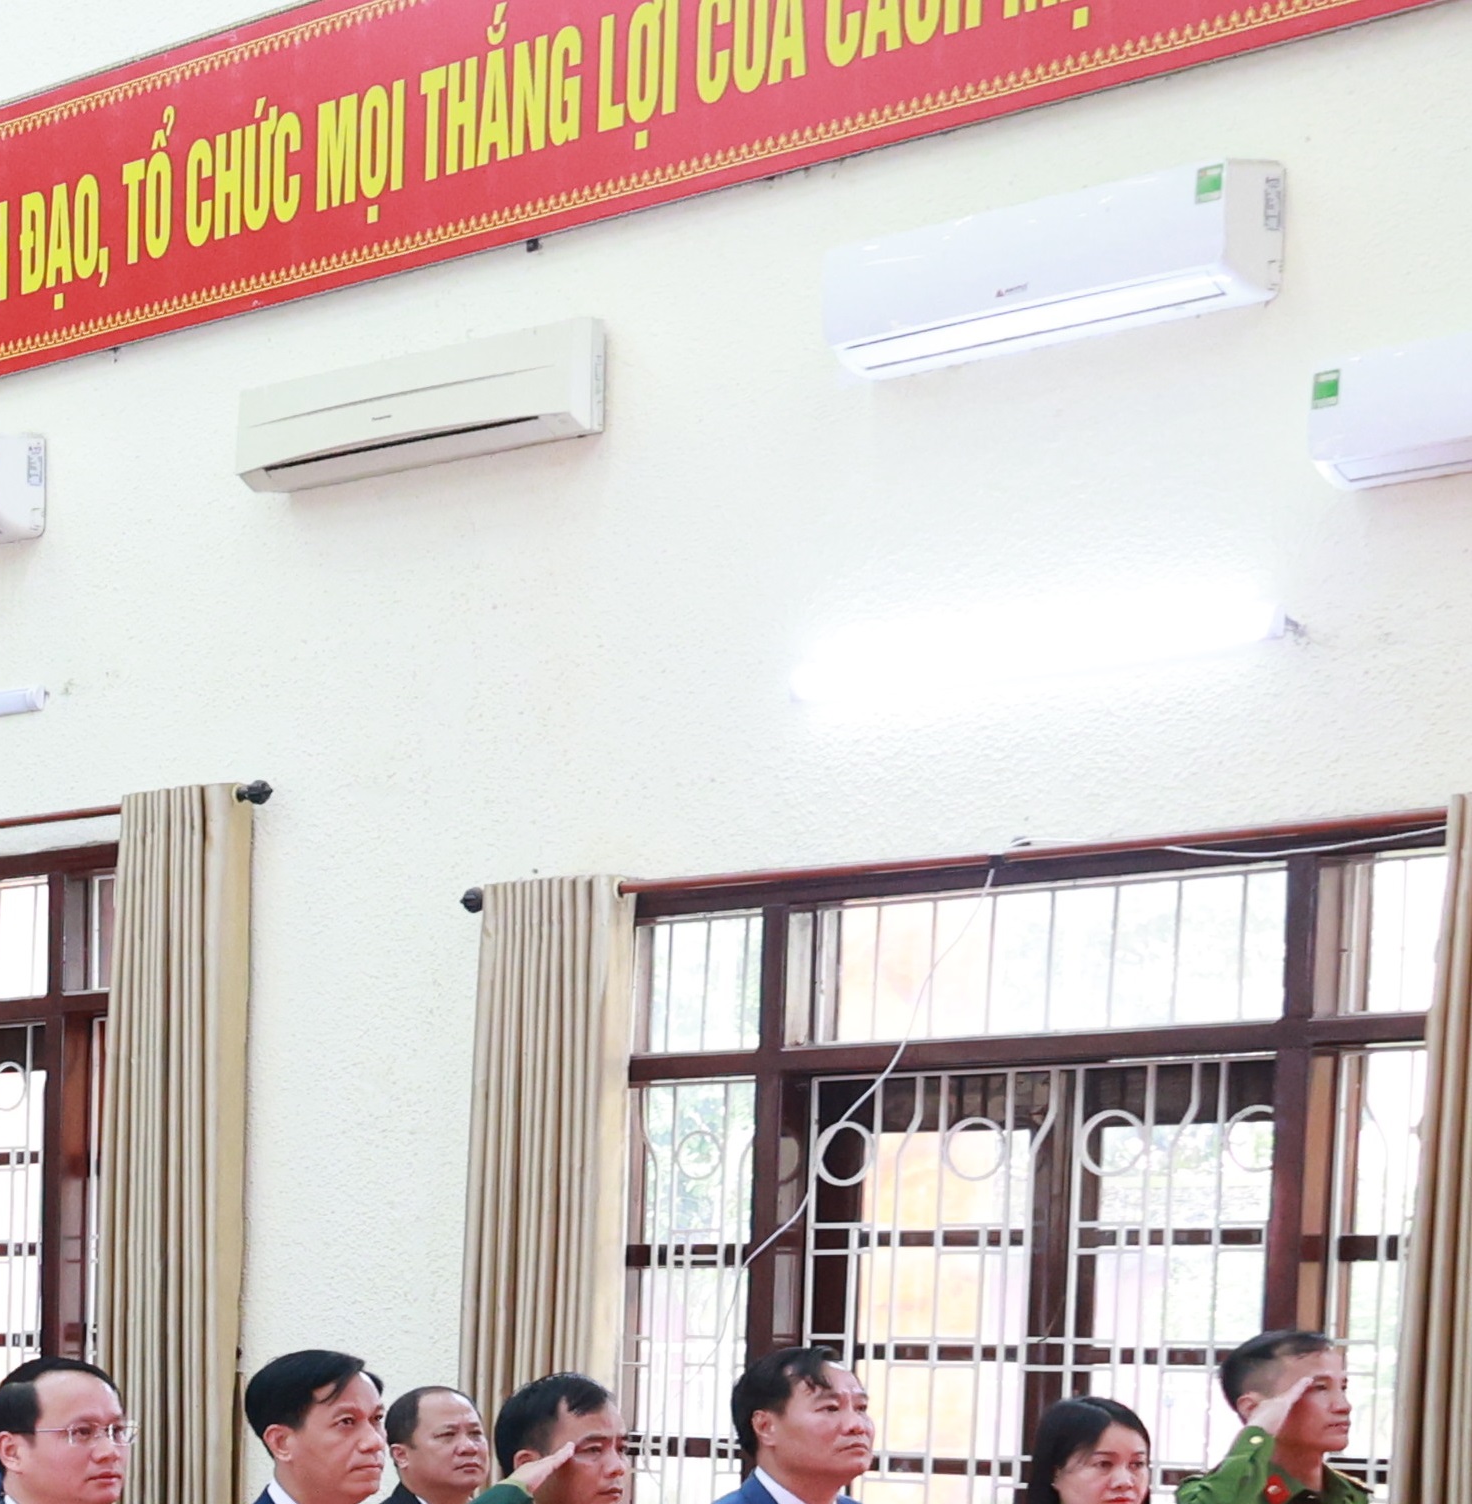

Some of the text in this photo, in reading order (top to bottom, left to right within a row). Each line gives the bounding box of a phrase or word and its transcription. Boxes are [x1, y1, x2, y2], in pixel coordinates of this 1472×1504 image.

[21, 175, 109, 310] ĐẠO,
[124, 106, 173, 263] TỔ
[188, 97, 302, 246] CHỨC
[318, 81, 405, 223] MỌI
[422, 8, 582, 180] THẮNG
[599, 0, 679, 150] LỢI
